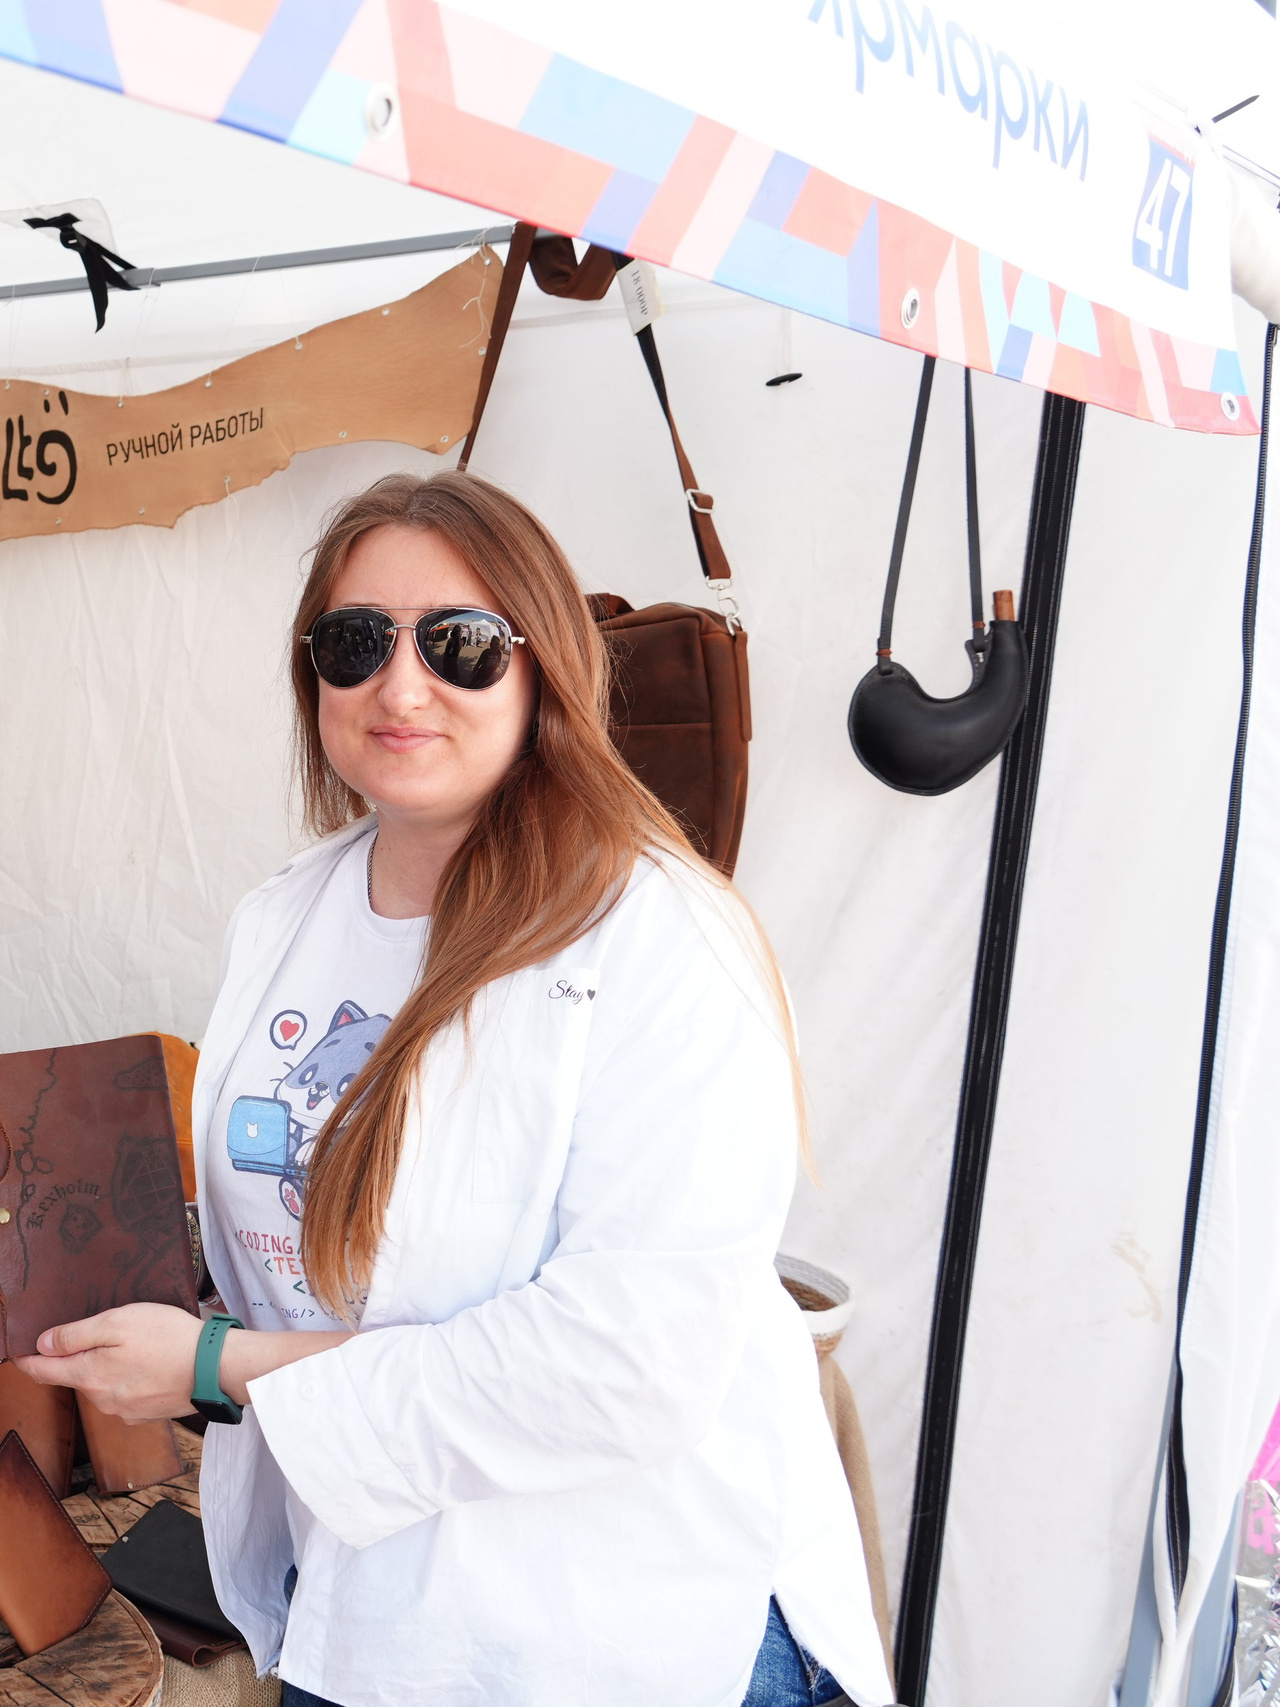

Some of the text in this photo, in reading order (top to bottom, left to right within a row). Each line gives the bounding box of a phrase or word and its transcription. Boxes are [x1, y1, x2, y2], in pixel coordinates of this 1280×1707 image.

[1135, 156, 1192, 278] 47
[106, 407, 264, 466] РУЧНОЙ РАБОТЫ
[548, 979, 585, 1005] Stay
